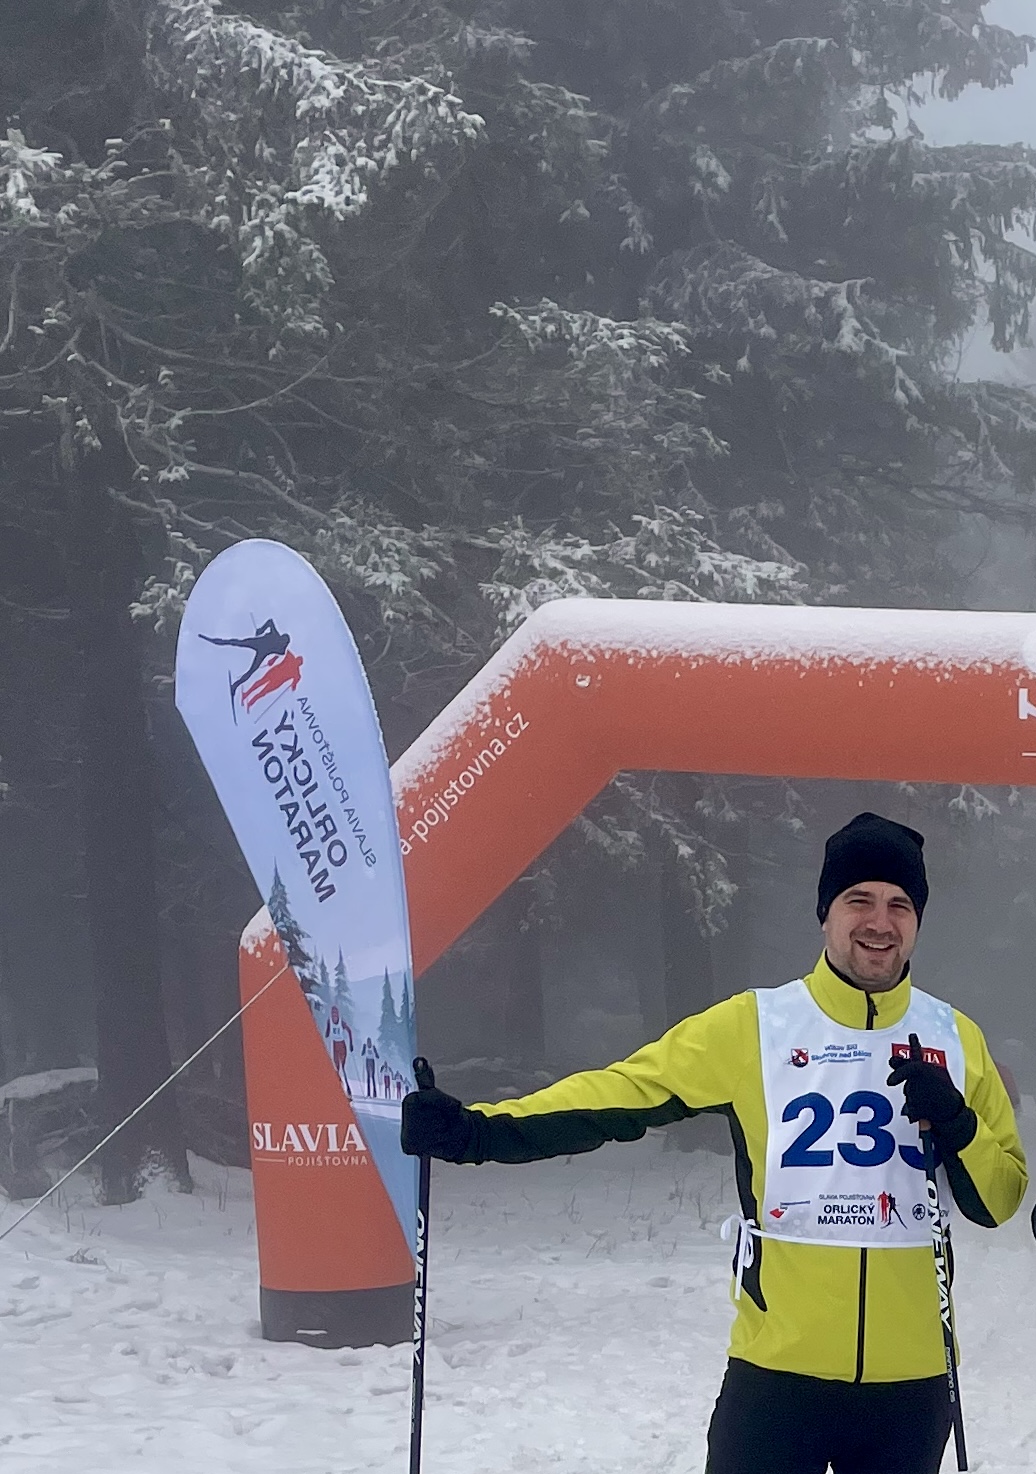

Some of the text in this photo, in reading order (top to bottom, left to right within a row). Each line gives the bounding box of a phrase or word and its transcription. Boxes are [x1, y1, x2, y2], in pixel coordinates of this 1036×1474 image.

[898, 1049, 940, 1064] SLIA
[253, 1122, 367, 1152] SLAVIA
[823, 1203, 875, 1214] ORLICKÝ
[817, 1215, 875, 1225] MARATON
